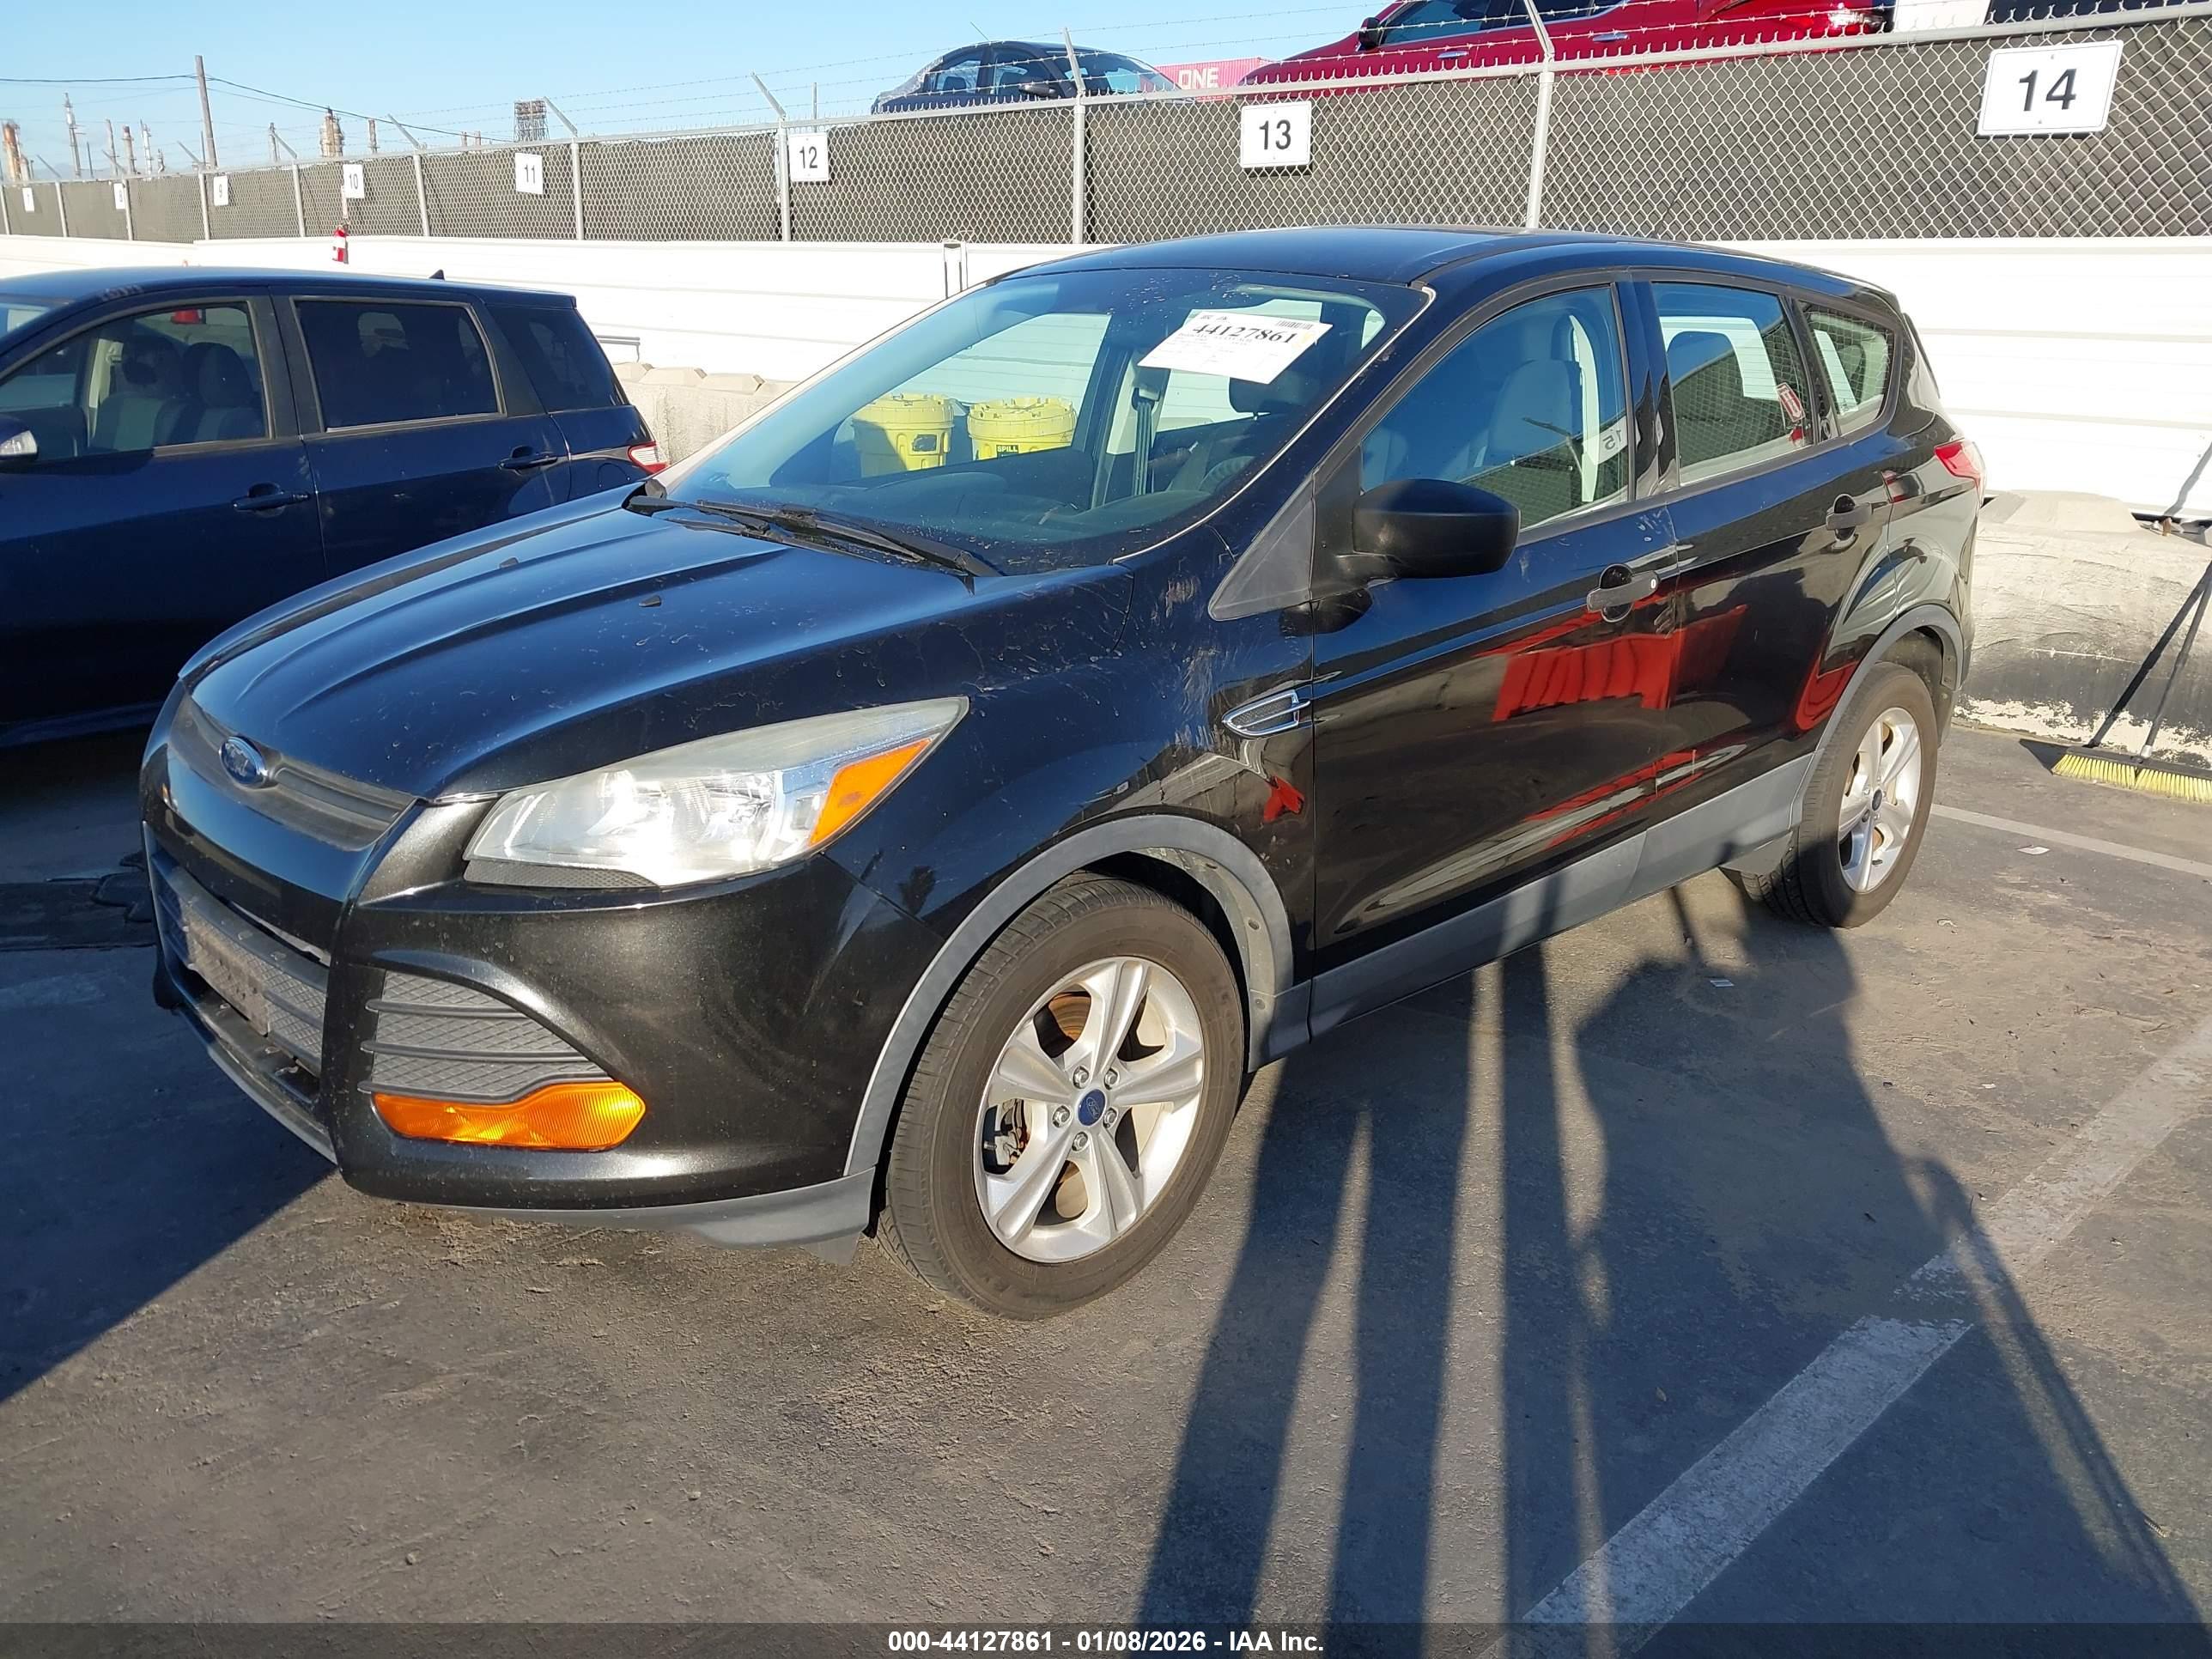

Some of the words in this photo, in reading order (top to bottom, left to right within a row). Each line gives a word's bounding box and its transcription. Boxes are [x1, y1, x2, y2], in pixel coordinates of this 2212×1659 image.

[1178, 68, 1219, 89] ONE
[2018, 68, 2077, 112] 14
[1259, 119, 1291, 150] 13
[799, 146, 818, 169] 12
[349, 173, 359, 190] 10
[524, 164, 536, 184] 11
[1192, 324, 1297, 343] 44127861
